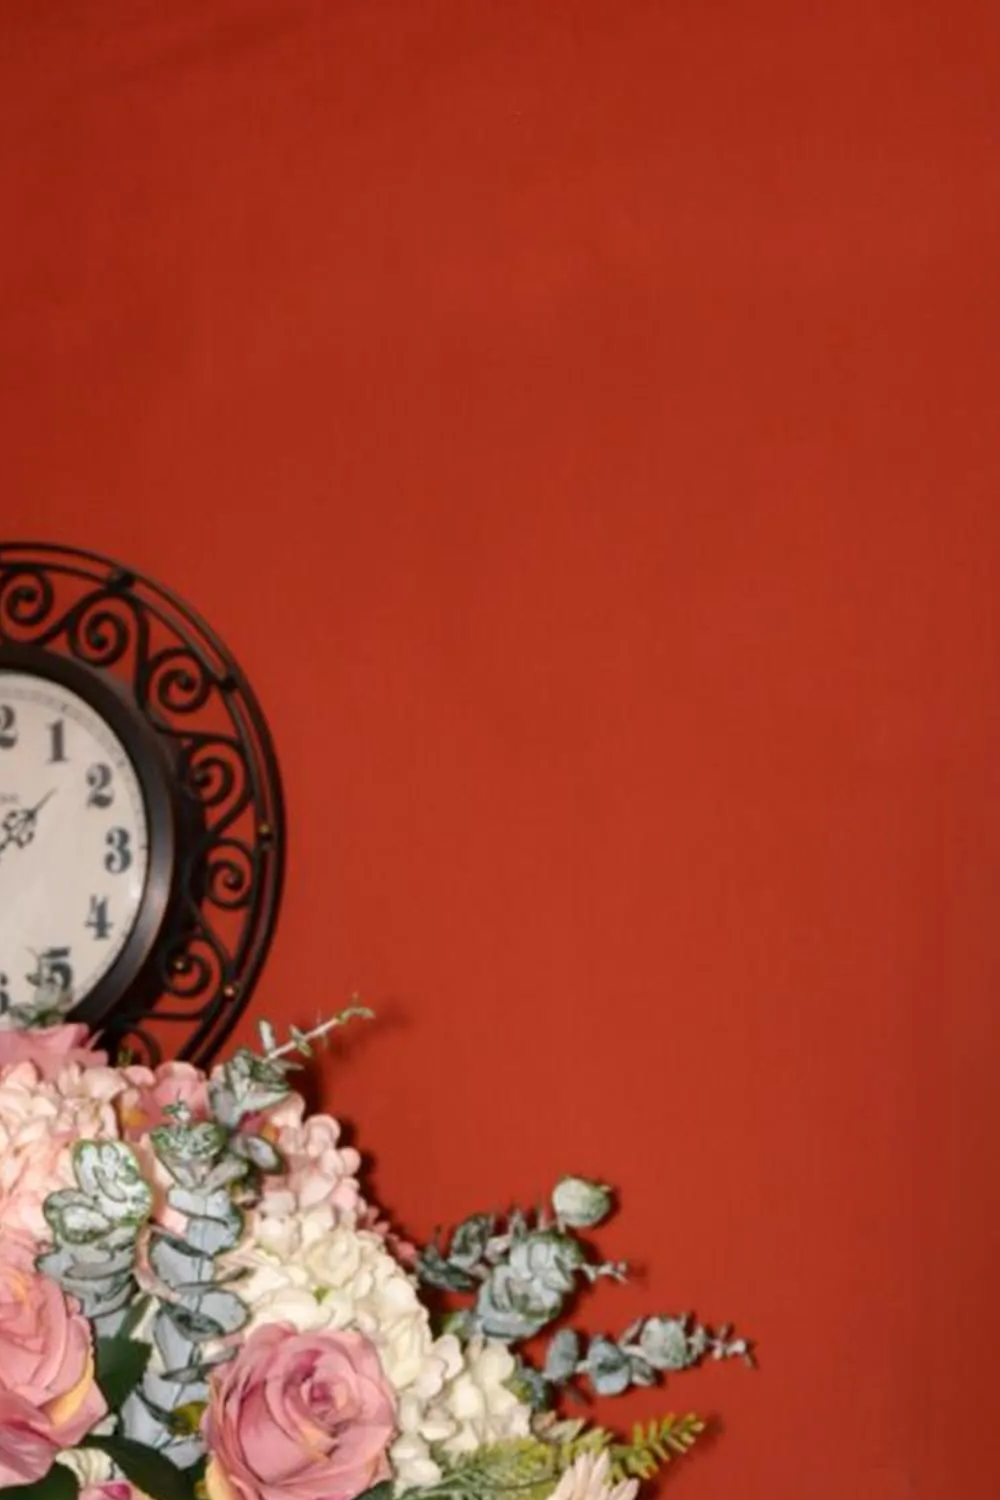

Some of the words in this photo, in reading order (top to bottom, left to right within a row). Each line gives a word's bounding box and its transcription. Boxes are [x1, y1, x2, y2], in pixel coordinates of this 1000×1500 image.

[46, 720, 66, 763] 1
[86, 763, 113, 808] 2
[104, 828, 131, 873] 3
[85, 895, 113, 939] 4
